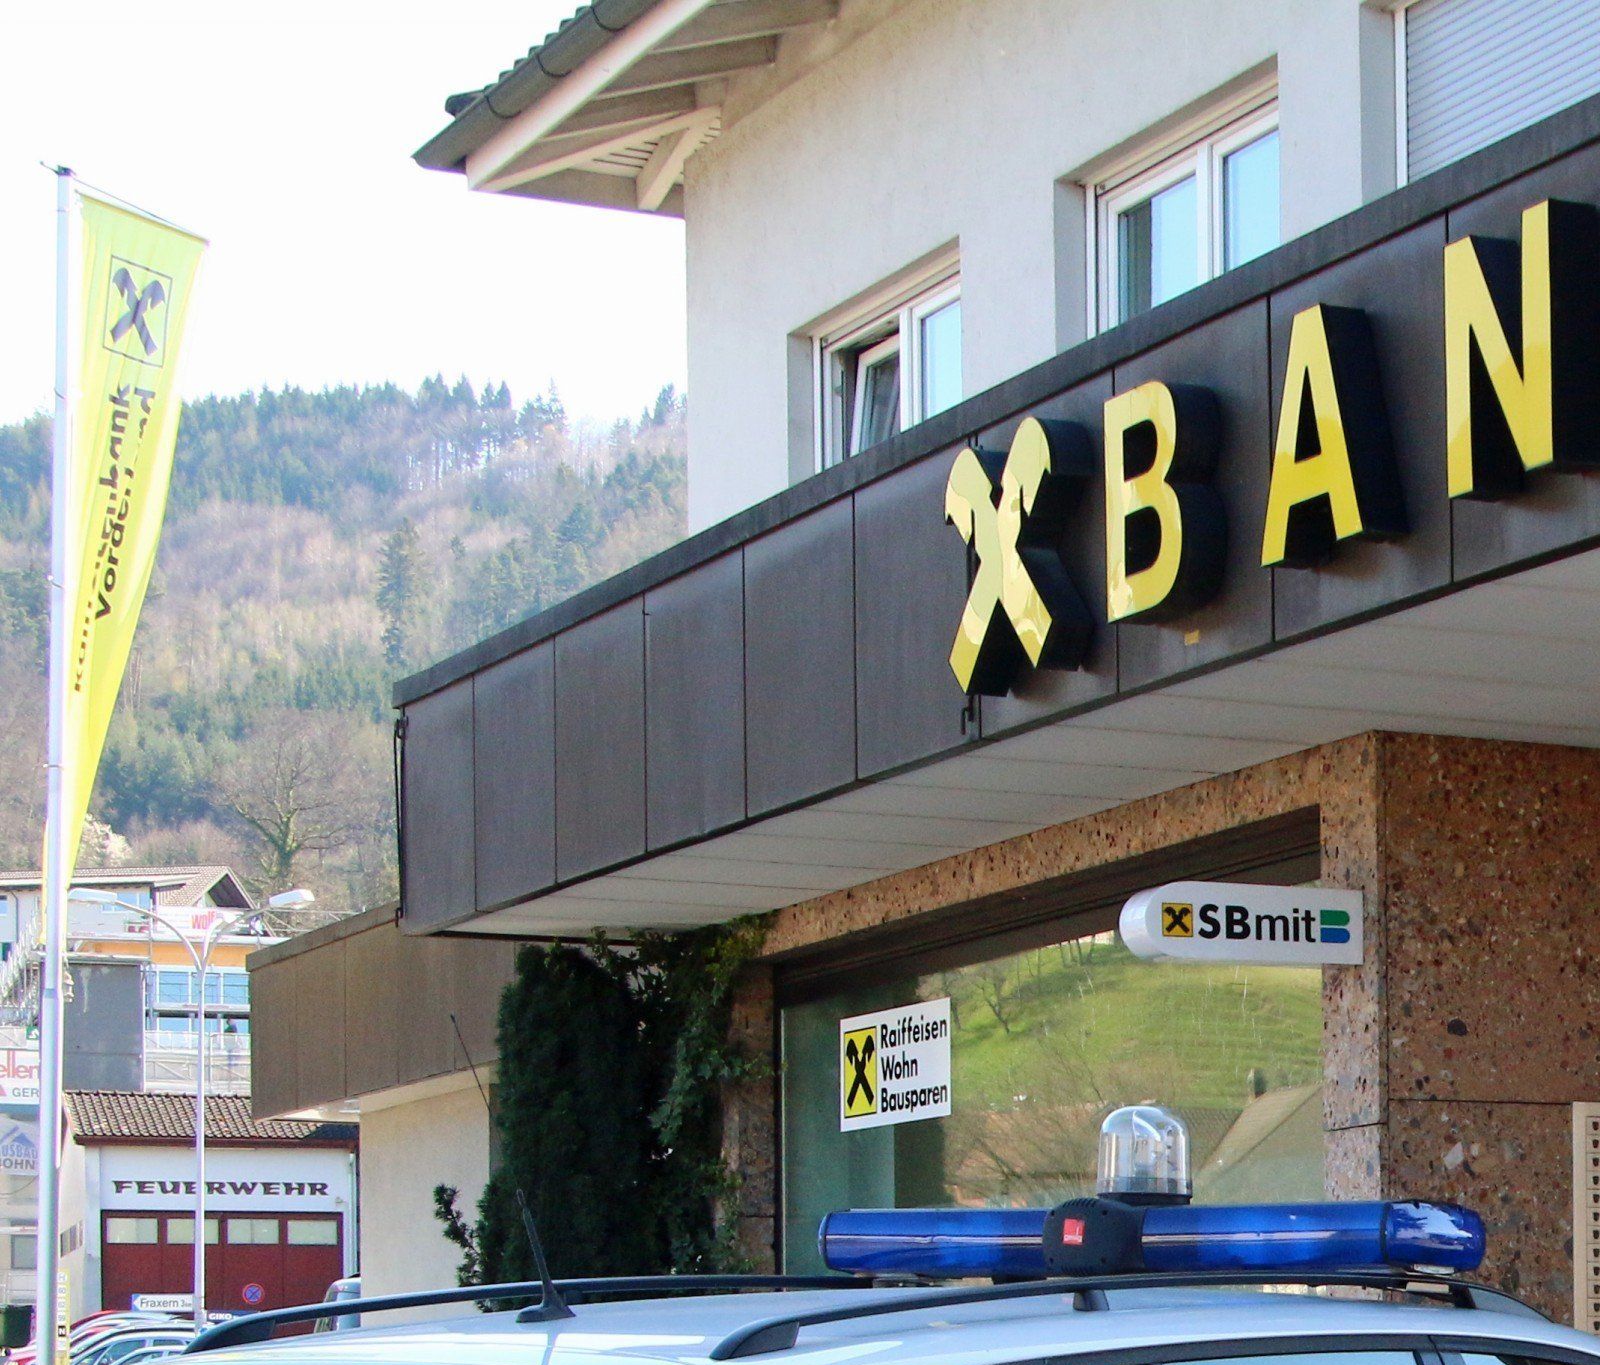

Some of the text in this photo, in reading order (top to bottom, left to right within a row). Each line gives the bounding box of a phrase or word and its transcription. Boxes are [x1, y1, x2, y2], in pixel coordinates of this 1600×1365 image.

[880, 1015, 948, 1049] Raiffeisen
[880, 1051, 918, 1081] Wohn
[880, 1084, 948, 1112] Bausparen
[112, 1180, 329, 1196] FEUERWEHR
